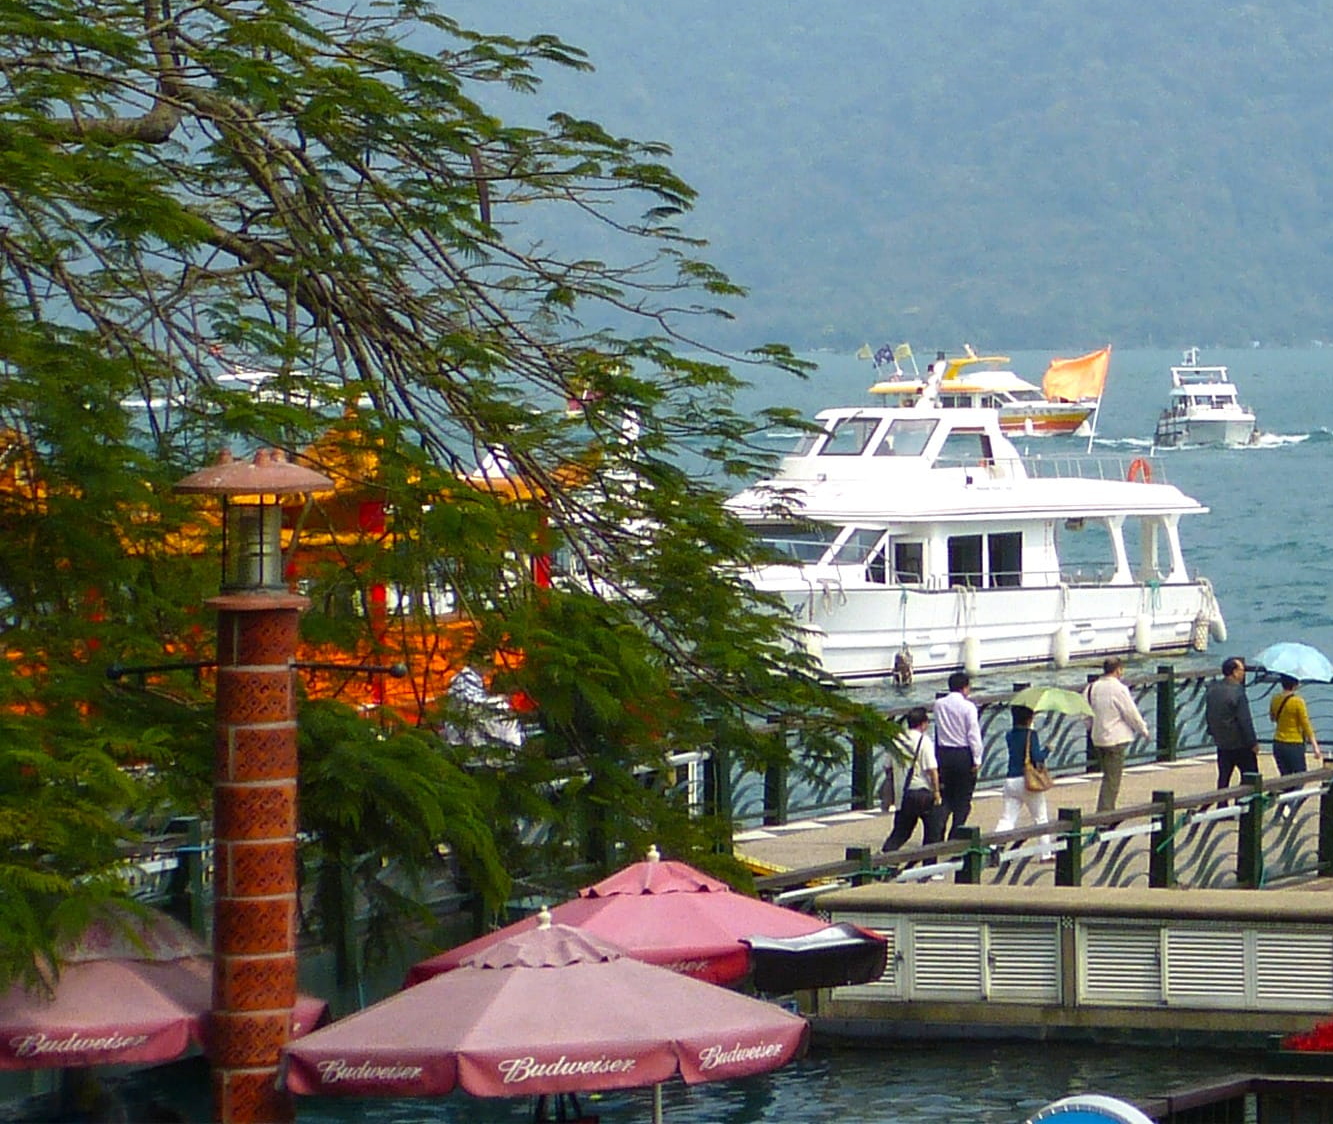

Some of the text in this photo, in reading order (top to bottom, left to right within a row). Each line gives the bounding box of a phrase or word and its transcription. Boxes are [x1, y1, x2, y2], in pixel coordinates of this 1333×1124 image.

[9, 1031, 149, 1058] Budweiser
[699, 1039, 784, 1072] Budweiser
[317, 1057, 424, 1085] Budweiser
[498, 1054, 636, 1084] Budweiser
